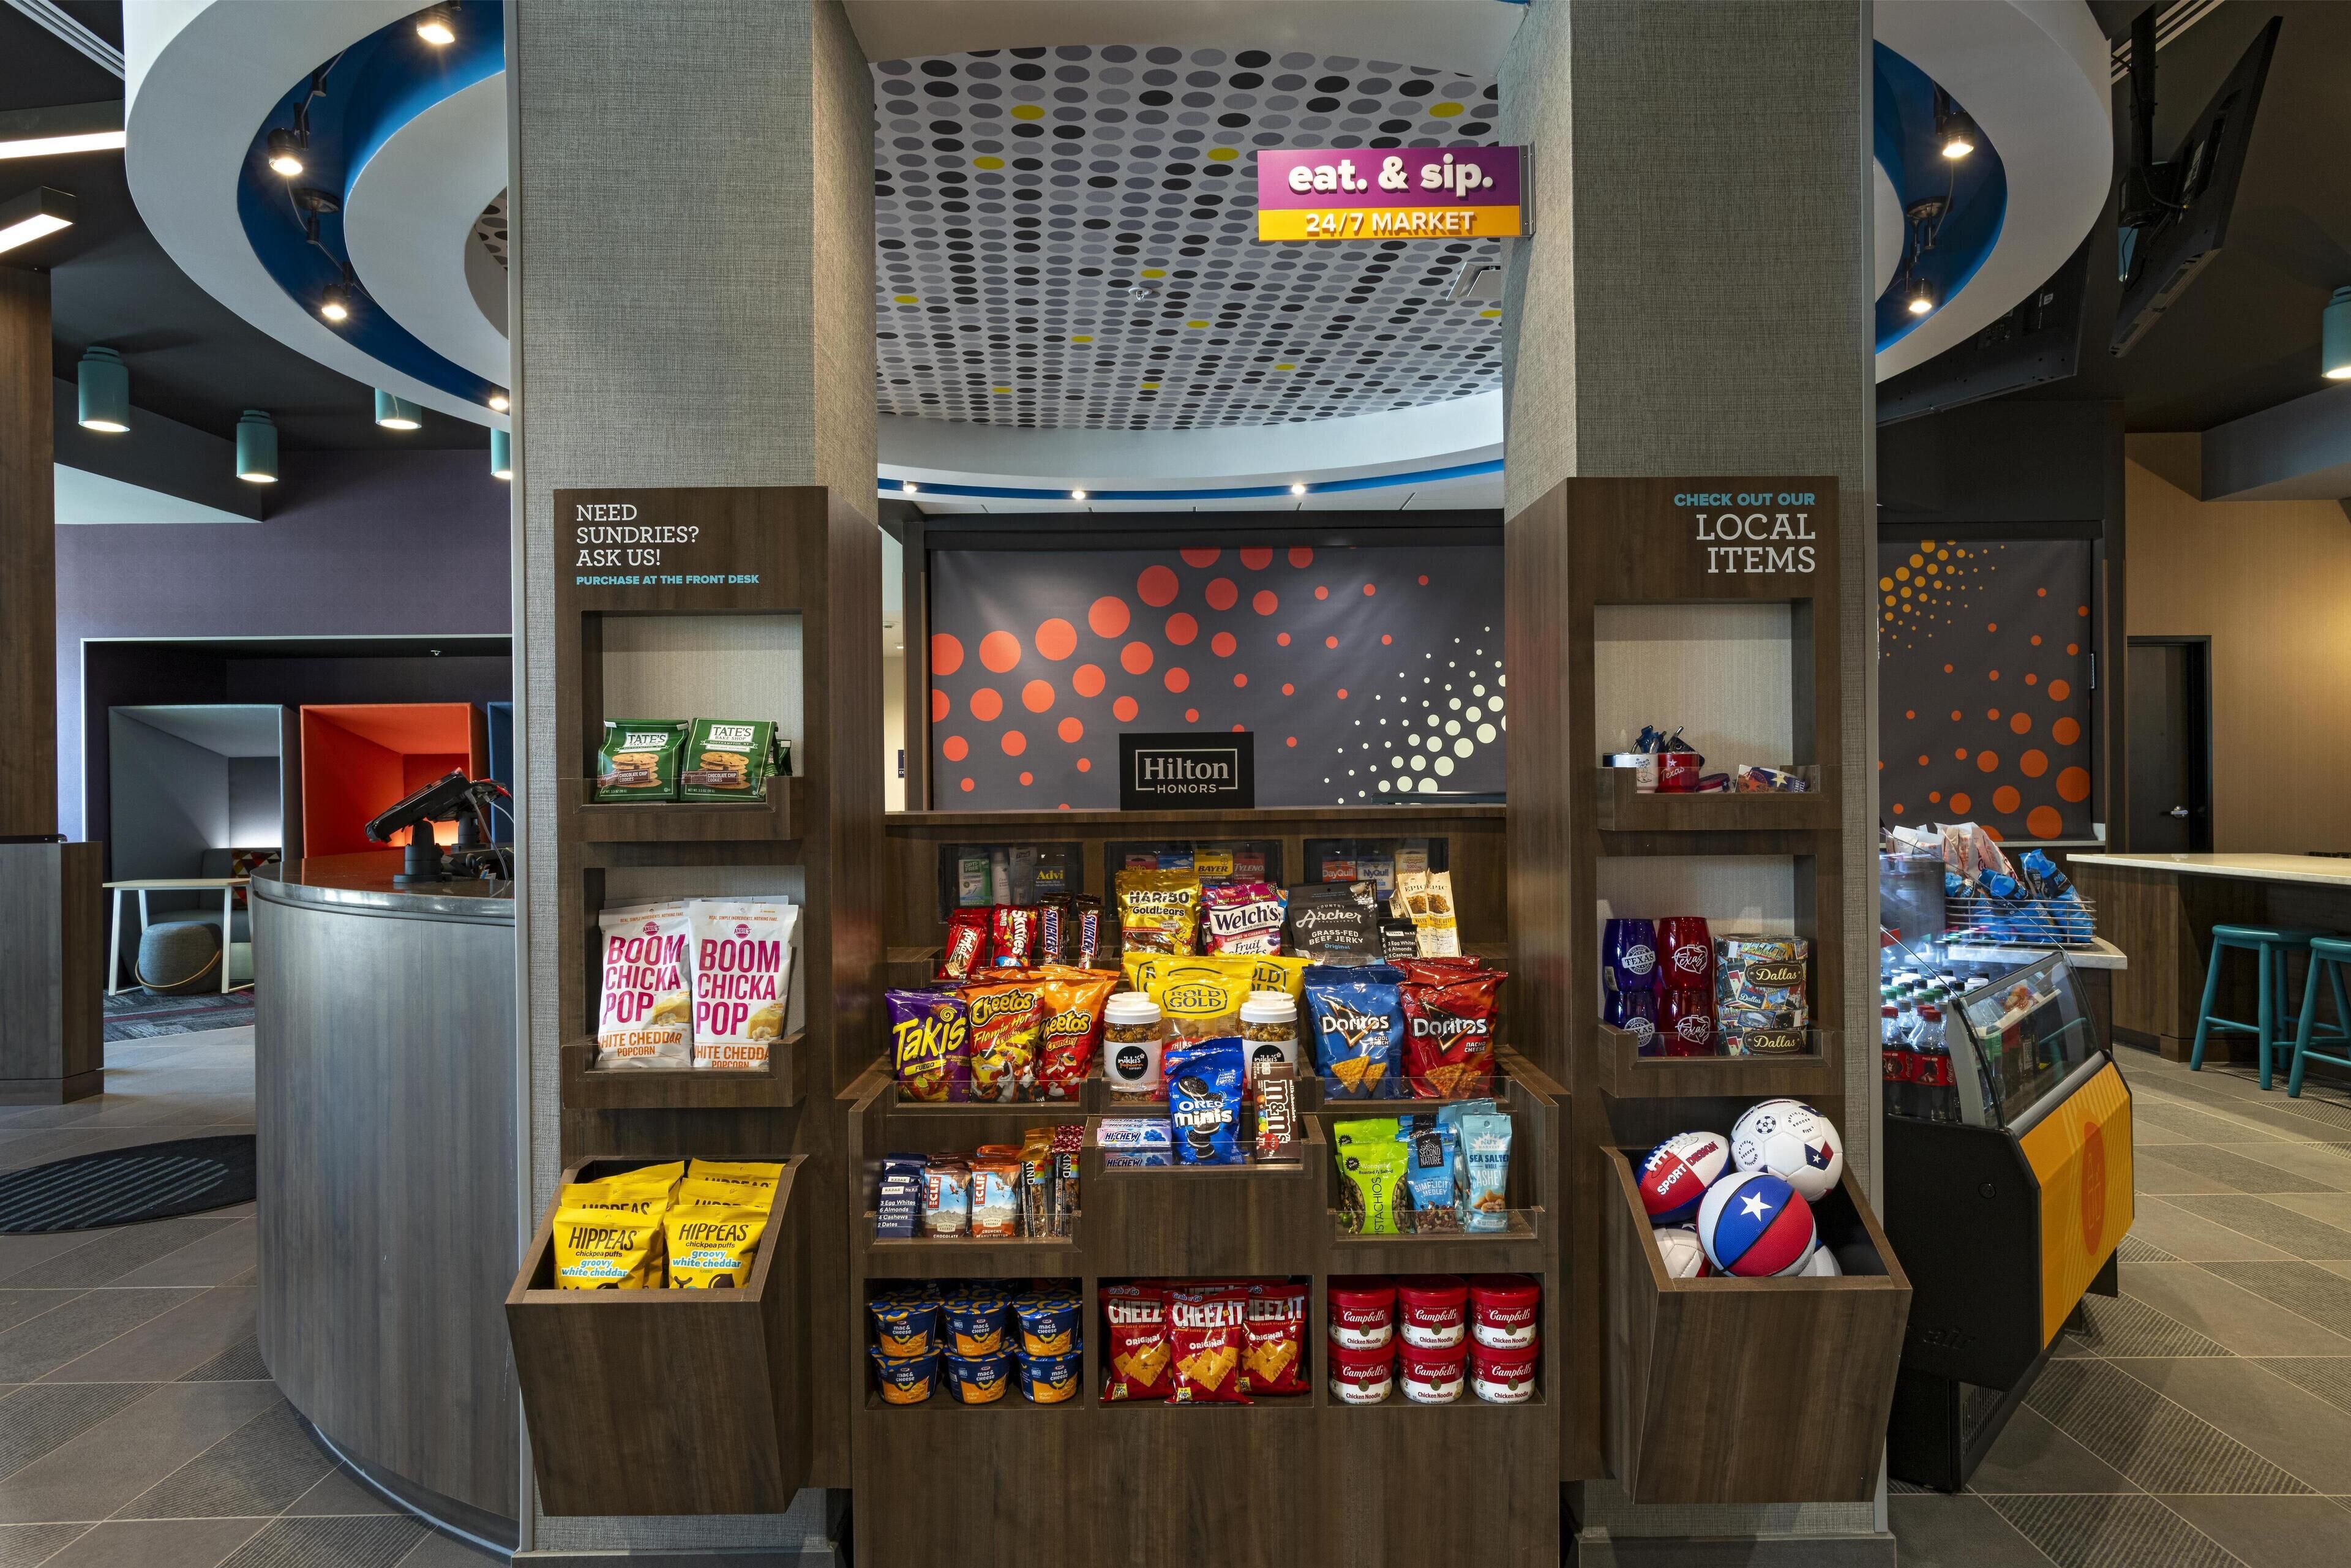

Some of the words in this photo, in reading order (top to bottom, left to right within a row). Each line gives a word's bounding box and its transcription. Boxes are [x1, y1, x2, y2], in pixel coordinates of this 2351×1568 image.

[1288, 159, 1367, 192] eat.
[1378, 156, 1409, 189] &
[1420, 153, 1493, 197] sip.
[1306, 213, 1363, 233] 24/7
[1371, 212, 1474, 231] MARKET
[1674, 493, 1733, 506] CHECK
[1737, 493, 1772, 506] OUT
[1778, 493, 1815, 505] OUR
[576, 505, 637, 521] NEED
[576, 526, 699, 544] SUNDRIES?
[1697, 514, 1815, 540] LOCAL
[576, 550, 621, 566] ASK
[627, 549, 661, 566] US!
[1708, 546, 1815, 573] ITEMS
[577, 576, 639, 585] PURCHASE
[643, 576, 657, 584] AT
[661, 576, 682, 584] THE
[686, 575, 725, 583] FRONT
[728, 575, 759, 583] DESK
[628, 735, 666, 743] TATE'S
[713, 727, 751, 737] TATE'S
[1144, 758, 1229, 779] Hilton
[1661, 767, 1684, 781] Texas
[1158, 784, 1217, 793] HONORS
[1323, 870, 1354, 879] DayQuil
[1363, 869, 1389, 878] NyQuil
[1130, 891, 1190, 904] HARIBO
[1133, 906, 1185, 916] Goldbears
[1213, 905, 1279, 931] Welch's
[1296, 910, 1361, 928] Archer
[1011, 910, 1027, 956] Skittles
[1045, 909, 1057, 954] SNICKERS
[1235, 940, 1261, 953] Fruit
[1309, 936, 1332, 945] BEEF
[607, 934, 686, 966] BOOM
[699, 939, 780, 972] BOOM
[1625, 954, 1654, 966] TEXAS
[605, 966, 681, 991] CHICKA
[1756, 968, 1796, 980] Dallas
[697, 973, 776, 1000] CHICKA
[1170, 997, 1221, 1007] GOLD
[1739, 993, 1761, 1003] Dallas
[602, 991, 654, 1025] POP
[972, 989, 1034, 1025] Cheetos
[696, 1002, 749, 1035] POP
[1322, 1015, 1390, 1033] Doritos
[1414, 1018, 1487, 1037] Doritos
[629, 1032, 681, 1046] CHEDDAR
[893, 1007, 966, 1070] Takis
[995, 1027, 1024, 1046] Crunchy
[1046, 1037, 1078, 1051] Crunchy
[617, 1046, 655, 1057] POPCORN
[915, 1062, 934, 1071] FUEGO
[1118, 1056, 1141, 1064] nikki's
[1179, 1100, 1224, 1111] OREO
[1174, 1108, 1232, 1127] minis
[1104, 1131, 1141, 1142] HI-CHEW
[1419, 1146, 1441, 1157] SECOND
[1685, 1141, 1719, 1166] DESIGN
[1063, 1153, 1071, 1178] KIND
[1420, 1155, 1441, 1166] NATURE
[1026, 1161, 1035, 1185] KIND
[1657, 1164, 1687, 1195] SPORT
[930, 1179, 940, 1201] CLIF
[975, 1176, 986, 1197] CLIF
[1414, 1181, 1452, 1193] SIMPLICITY
[1371, 1177, 1384, 1234] ISTACHIOS
[569, 1227, 637, 1250] HIPPEAS
[679, 1223, 749, 1242] HIPPEAS
[581, 1259, 612, 1268] groovy
[672, 1258, 702, 1267] white
[561, 1268, 588, 1277] white
[590, 1269, 628, 1277] cheddar
[1343, 1310, 1384, 1324] Campbell's
[1342, 1365, 1383, 1379] Campbell's
